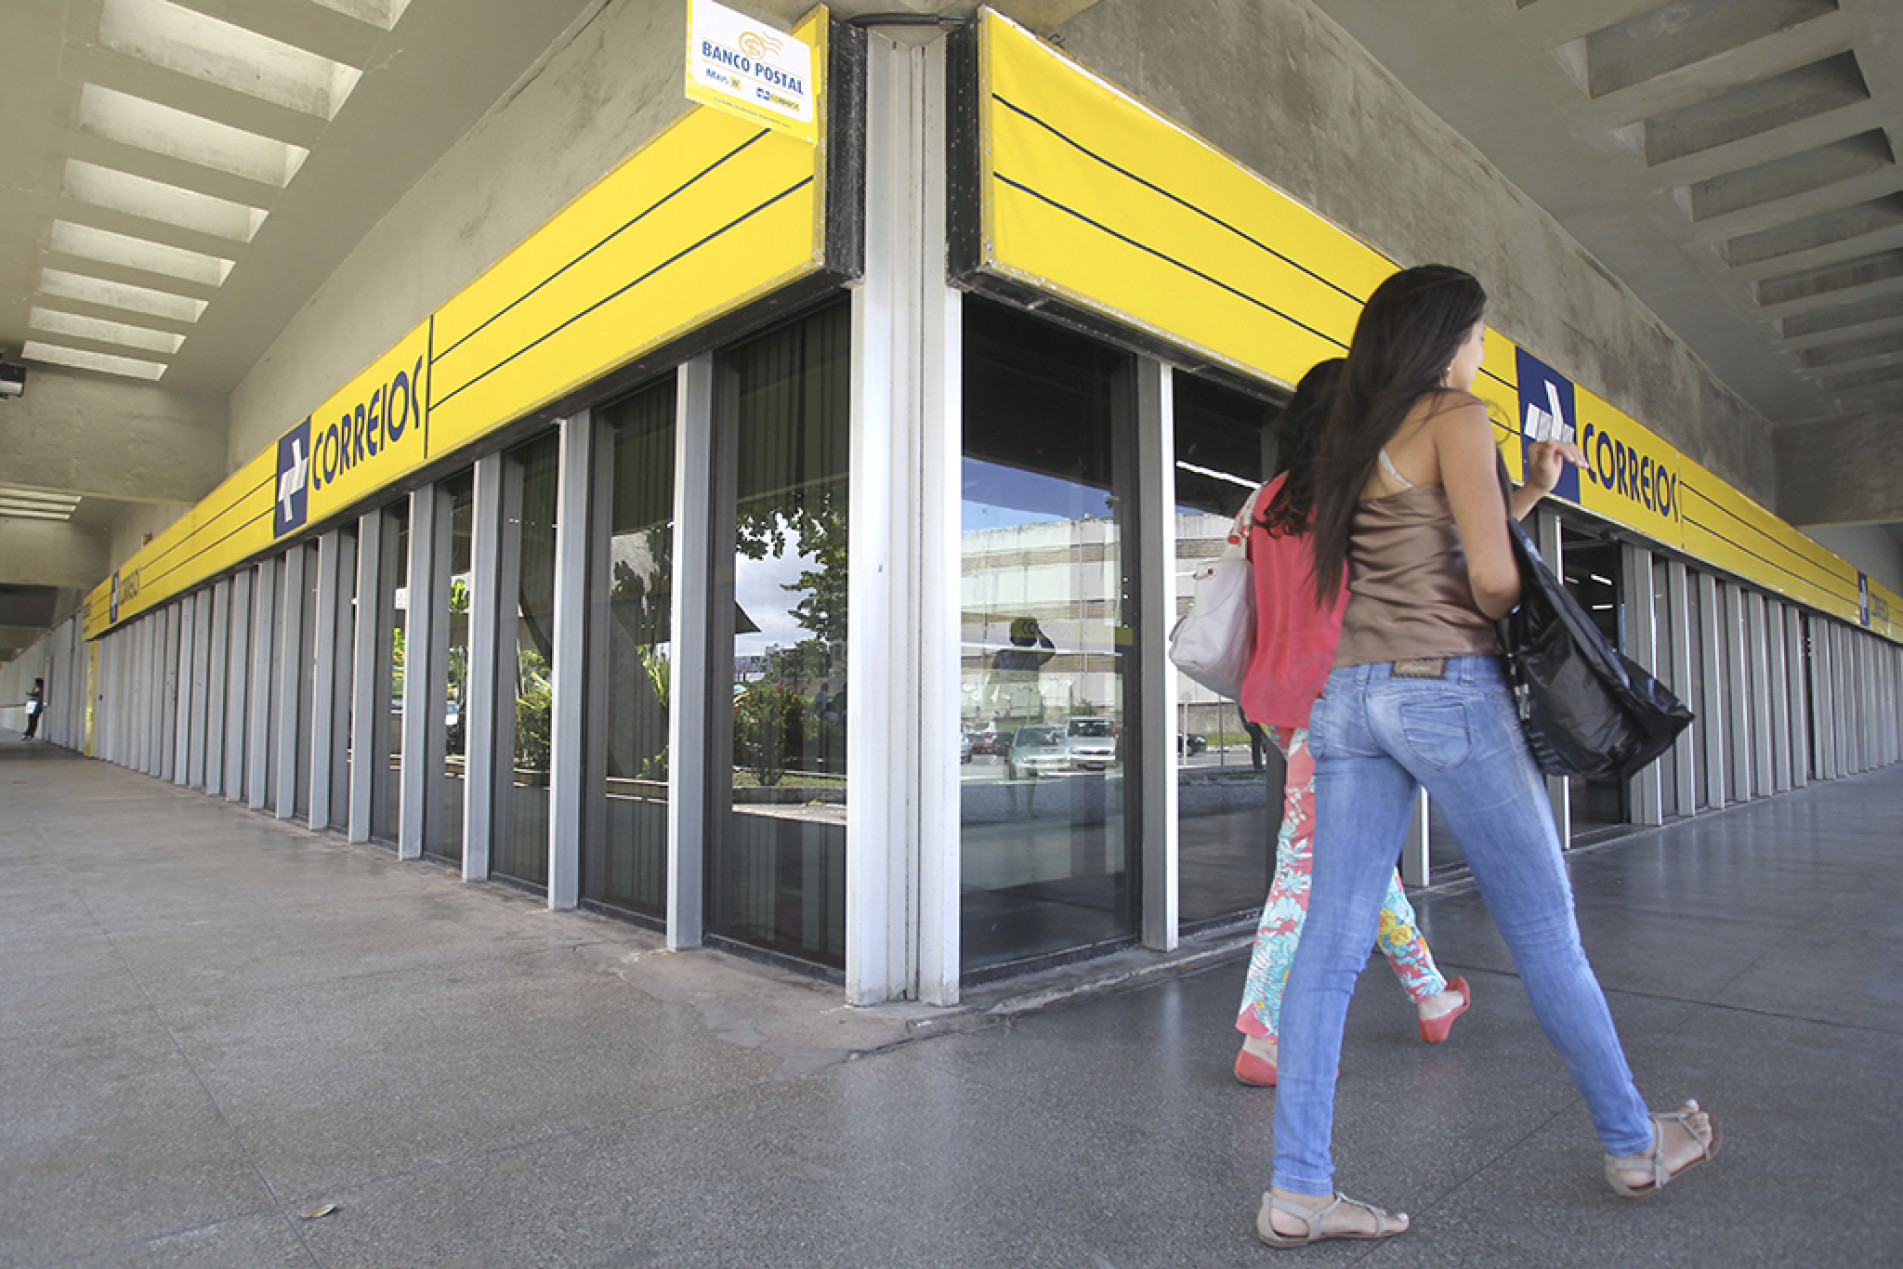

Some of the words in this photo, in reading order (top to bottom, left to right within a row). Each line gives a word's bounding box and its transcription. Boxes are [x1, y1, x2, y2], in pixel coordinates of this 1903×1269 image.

[702, 40, 749, 72] BANCO
[755, 62, 803, 95] POSTAL
[313, 354, 423, 491] CORREIOS
[1582, 422, 1679, 523] CORREIOS
